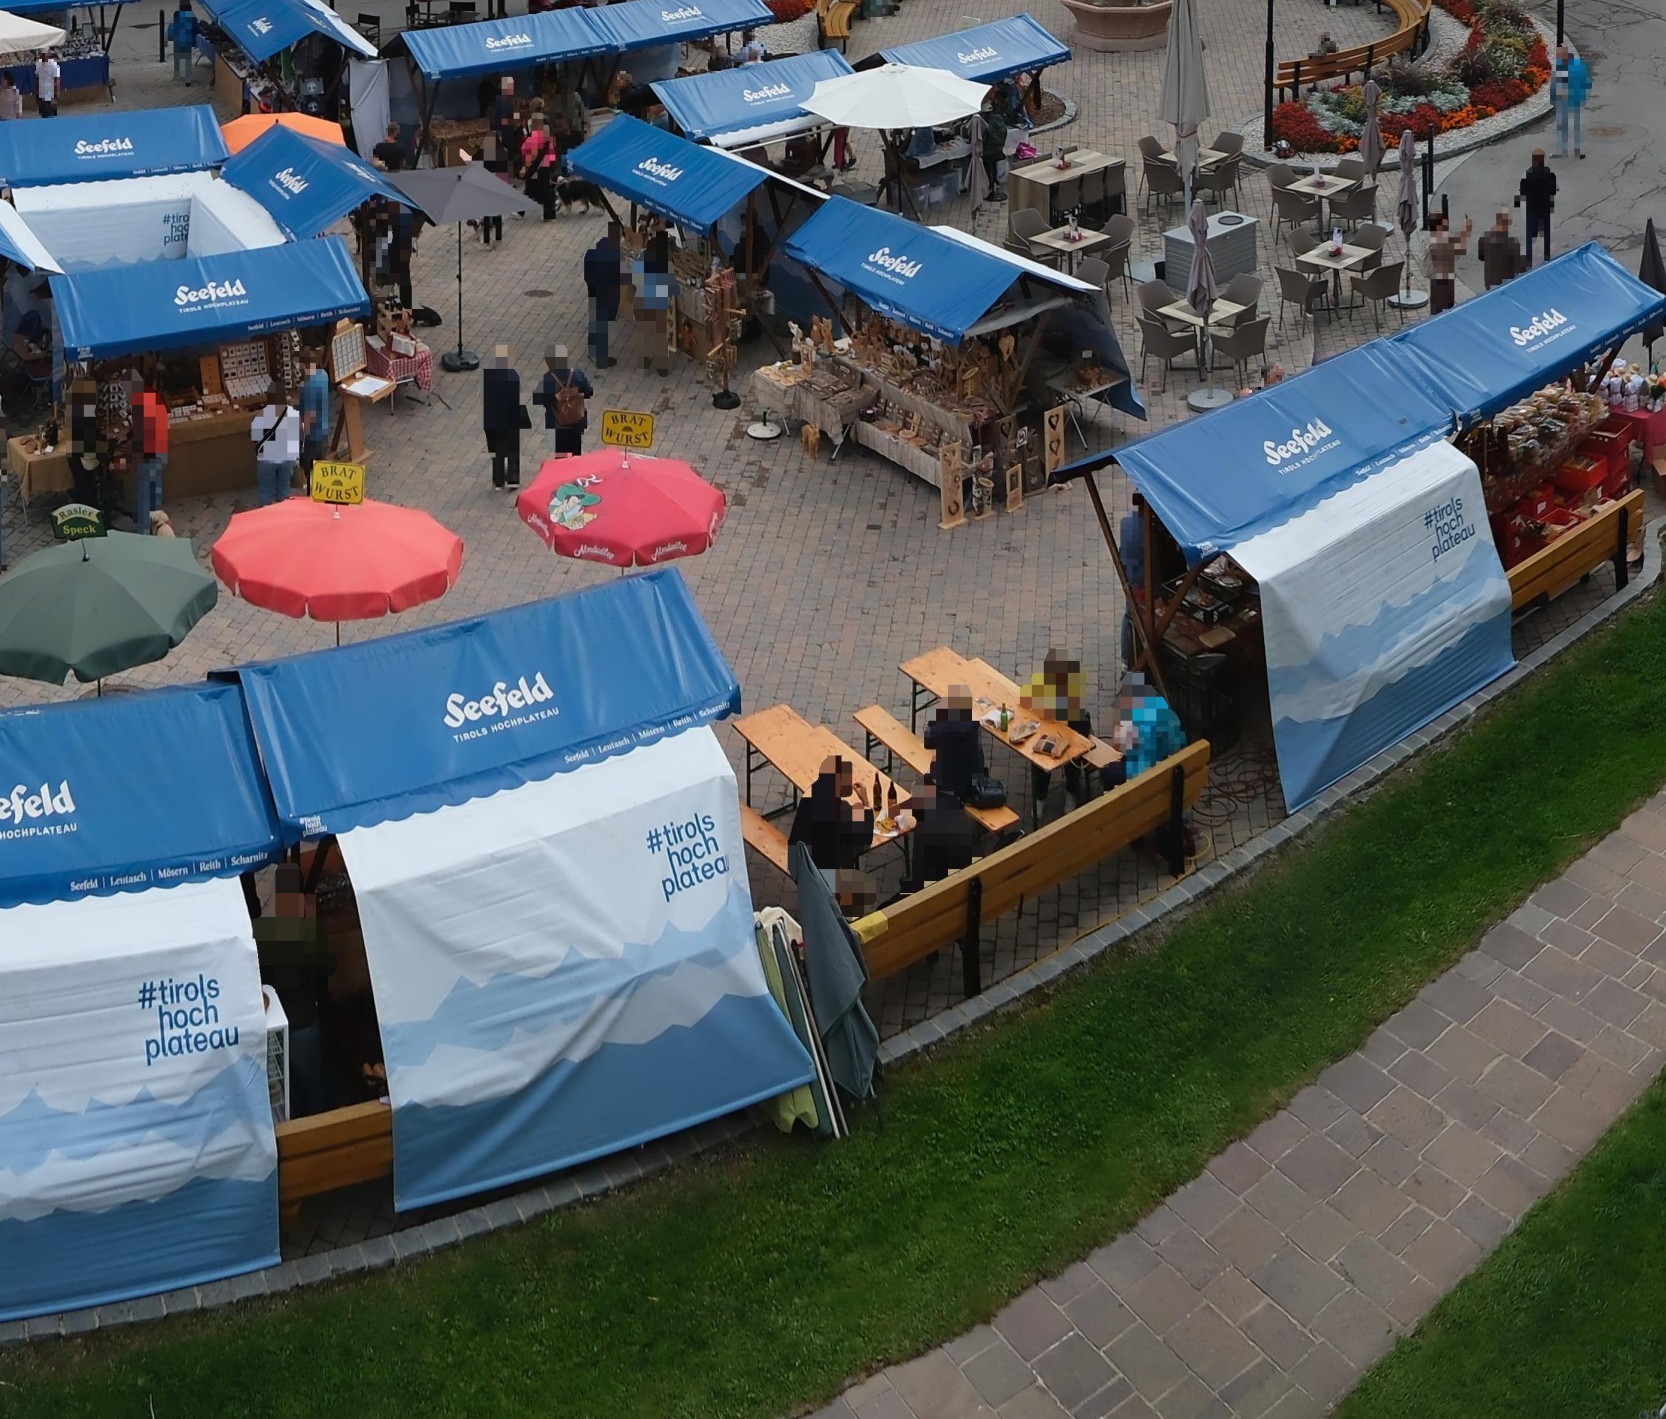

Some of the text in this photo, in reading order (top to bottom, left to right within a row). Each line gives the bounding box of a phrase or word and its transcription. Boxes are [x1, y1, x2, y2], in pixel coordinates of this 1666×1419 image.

[660, 5, 702, 22] Seefeld
[485, 33, 532, 50] Seefeld
[956, 46, 998, 64] Seefeld
[742, 82, 792, 103] Seefeld
[73, 136, 134, 156] Seefeld
[274, 167, 309, 195] Seefeld
[637, 156, 685, 182] Seefeld
[868, 246, 925, 279] Seefeld
[173, 277, 247, 306] Seefeld
[178, 298, 249, 314] TIROLS HOCHPLATEAU
[1508, 306, 1568, 347] Seefeld
[1525, 324, 1577, 354] TIROLS HOCHPLATEAU
[611, 414, 647, 427] BRAT
[605, 427, 649, 445] WURST
[1262, 416, 1333, 467] Seefeld
[320, 464, 358, 481] BRAT
[314, 481, 360, 501] WURST
[57, 505, 95, 522] Rasler
[1423, 496, 1463, 530] #tirols
[63, 524, 97, 535] Speck
[1431, 522, 1477, 564] plateau
[1434, 512, 1465, 550] hoch
[443, 670, 555, 729] Seefeld
[452, 707, 560, 744] TIROLS HOCHPLATEAU
[564, 701, 731, 764] Seefeld Leutasch Mösern Reith Scharnitz
[646, 812, 715, 856] #tirols
[666, 830, 720, 870] hoch
[70, 851, 269, 892] Seefeld Leutasch Mösern Reith Scharnitz
[138, 974, 221, 1010] #tirols
[157, 996, 219, 1030] hoch
[145, 1026, 239, 1067] plateau
